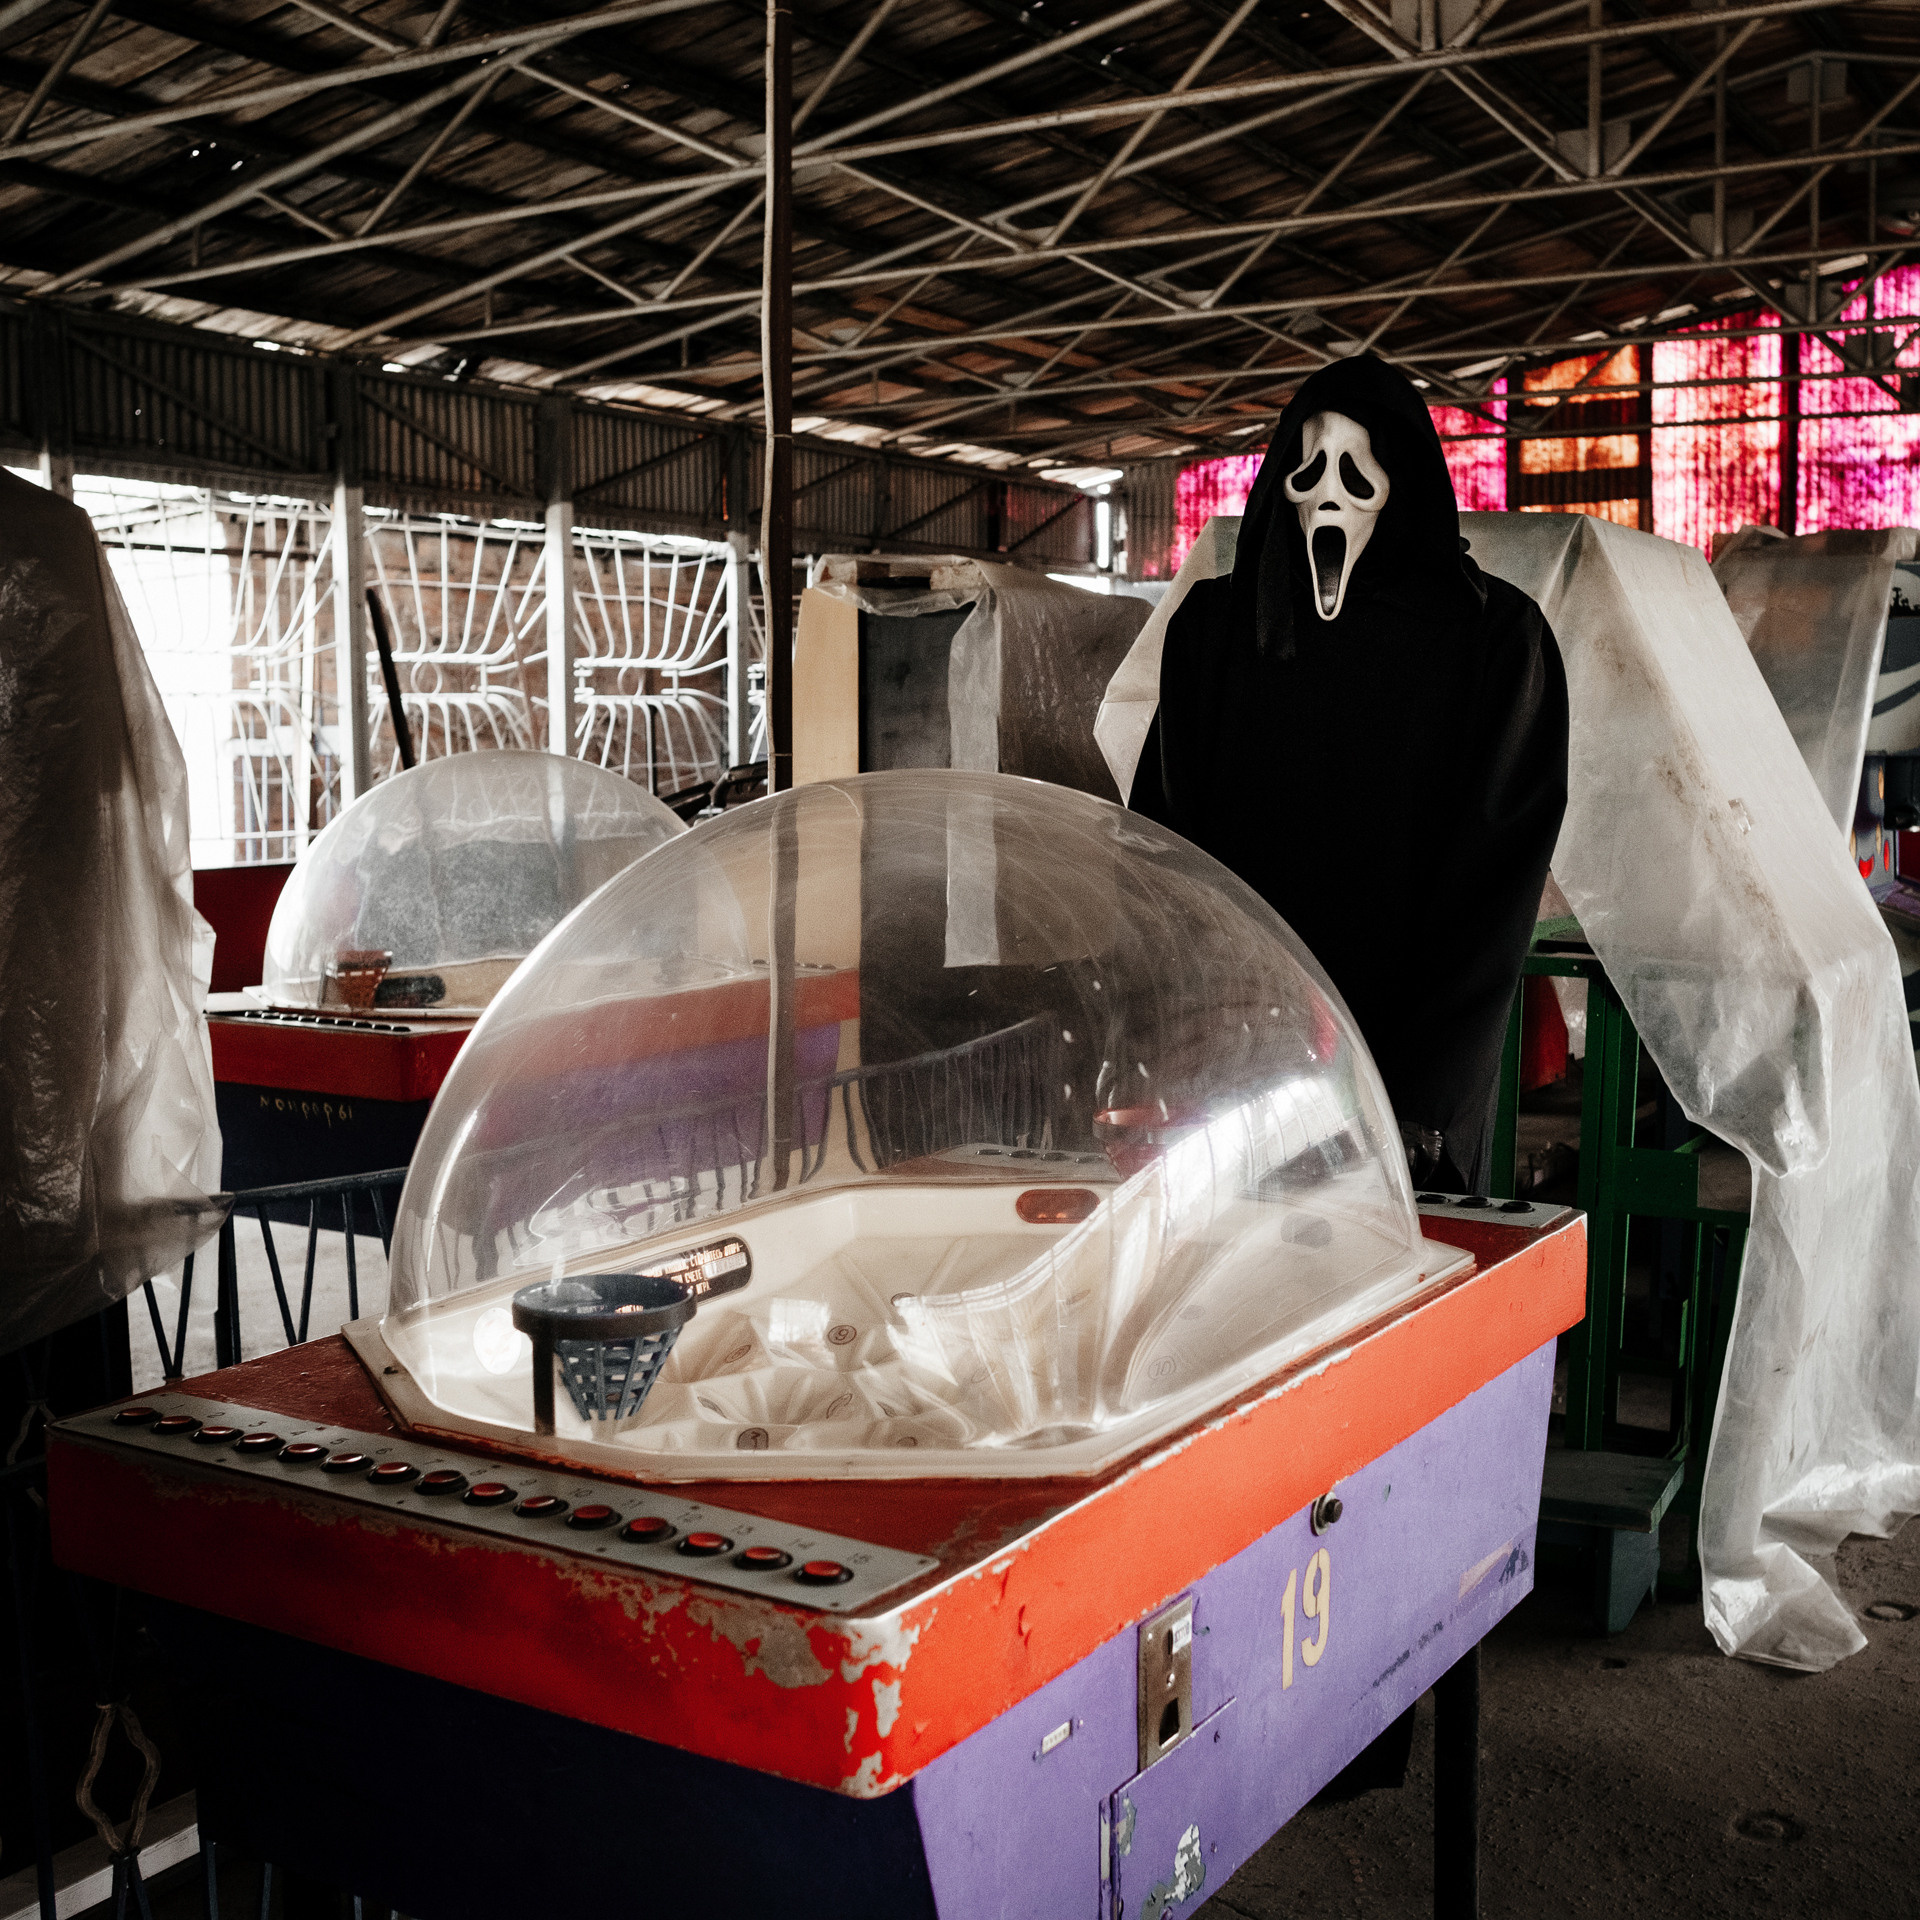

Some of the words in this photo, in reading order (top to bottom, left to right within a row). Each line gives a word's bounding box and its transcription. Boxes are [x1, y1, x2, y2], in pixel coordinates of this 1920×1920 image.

[206, 1411, 226, 1419] 2
[248, 1420, 267, 1428] 3
[1280, 1546, 1331, 1691] 19
